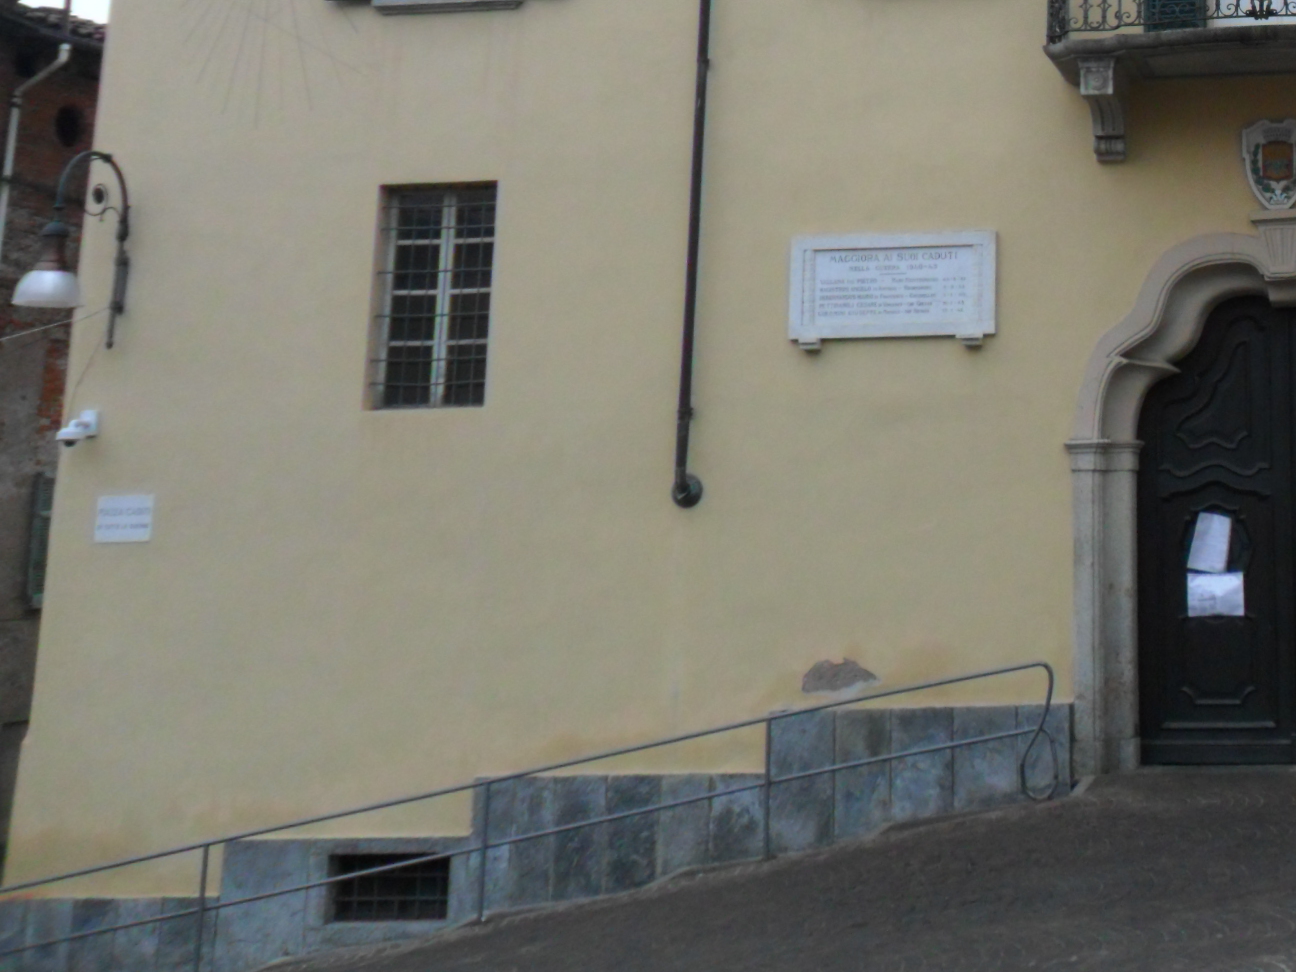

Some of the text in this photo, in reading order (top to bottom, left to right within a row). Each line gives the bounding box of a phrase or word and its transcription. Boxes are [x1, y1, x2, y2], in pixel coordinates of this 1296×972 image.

[829, 251, 958, 263] MAGGIORA AI SUOI CADUTI
